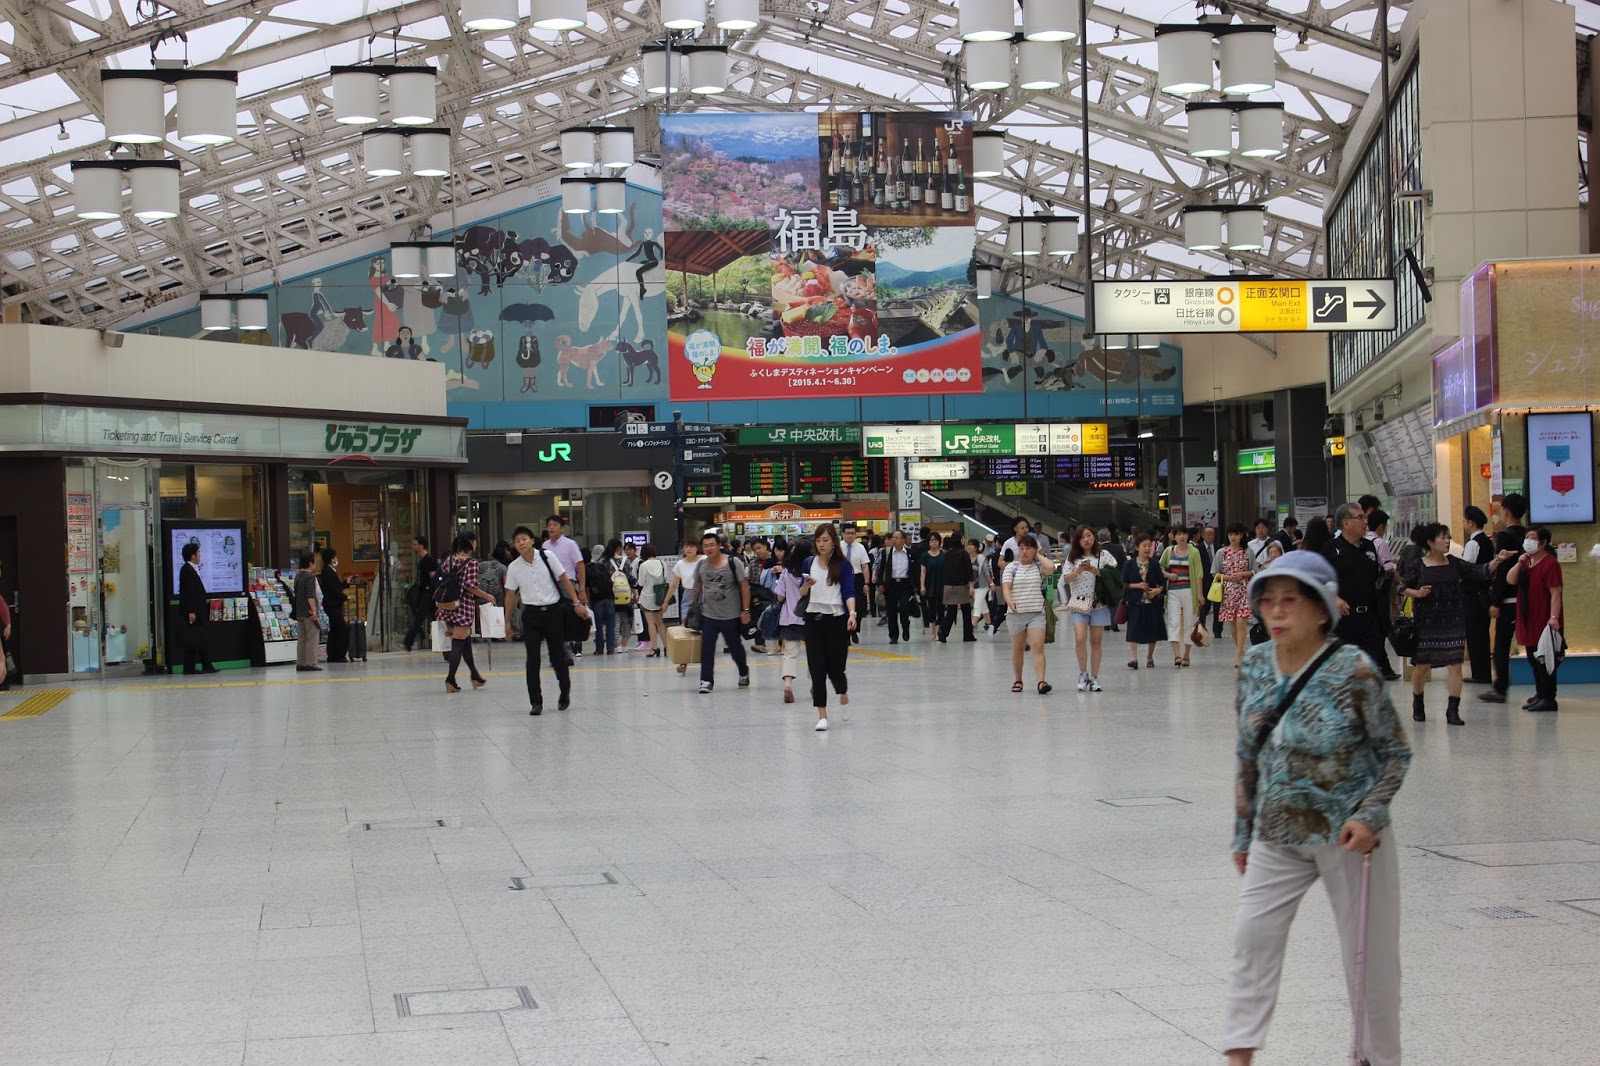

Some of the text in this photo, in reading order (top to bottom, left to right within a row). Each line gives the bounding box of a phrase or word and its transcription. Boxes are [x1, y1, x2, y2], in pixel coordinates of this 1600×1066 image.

[944, 119, 964, 131] JR
[774, 206, 868, 252] 福島
[1113, 288, 1151, 298] タクシー
[1184, 287, 1214, 298] 銀座線
[1246, 287, 1301, 298] 正面玄関口
[1176, 308, 1215, 318] 日比谷線
[748, 334, 898, 358] 福が満開、福のしま。
[749, 366, 894, 378] ふくしまデスティネーションキャンペーン
[103, 429, 239, 445] Ticketing and Travel Service Center
[325, 423, 423, 454] びゅうプラザ
[768, 428, 787, 439] JR
[790, 428, 843, 442] 中央改札
[971, 434, 1001, 443] 中央改札
[945, 434, 970, 450] JR
[538, 443, 572, 462] JR
[1252, 452, 1275, 466] NewDays
[904, 482, 914, 508] のりば
[1187, 487, 1215, 496] ecute
